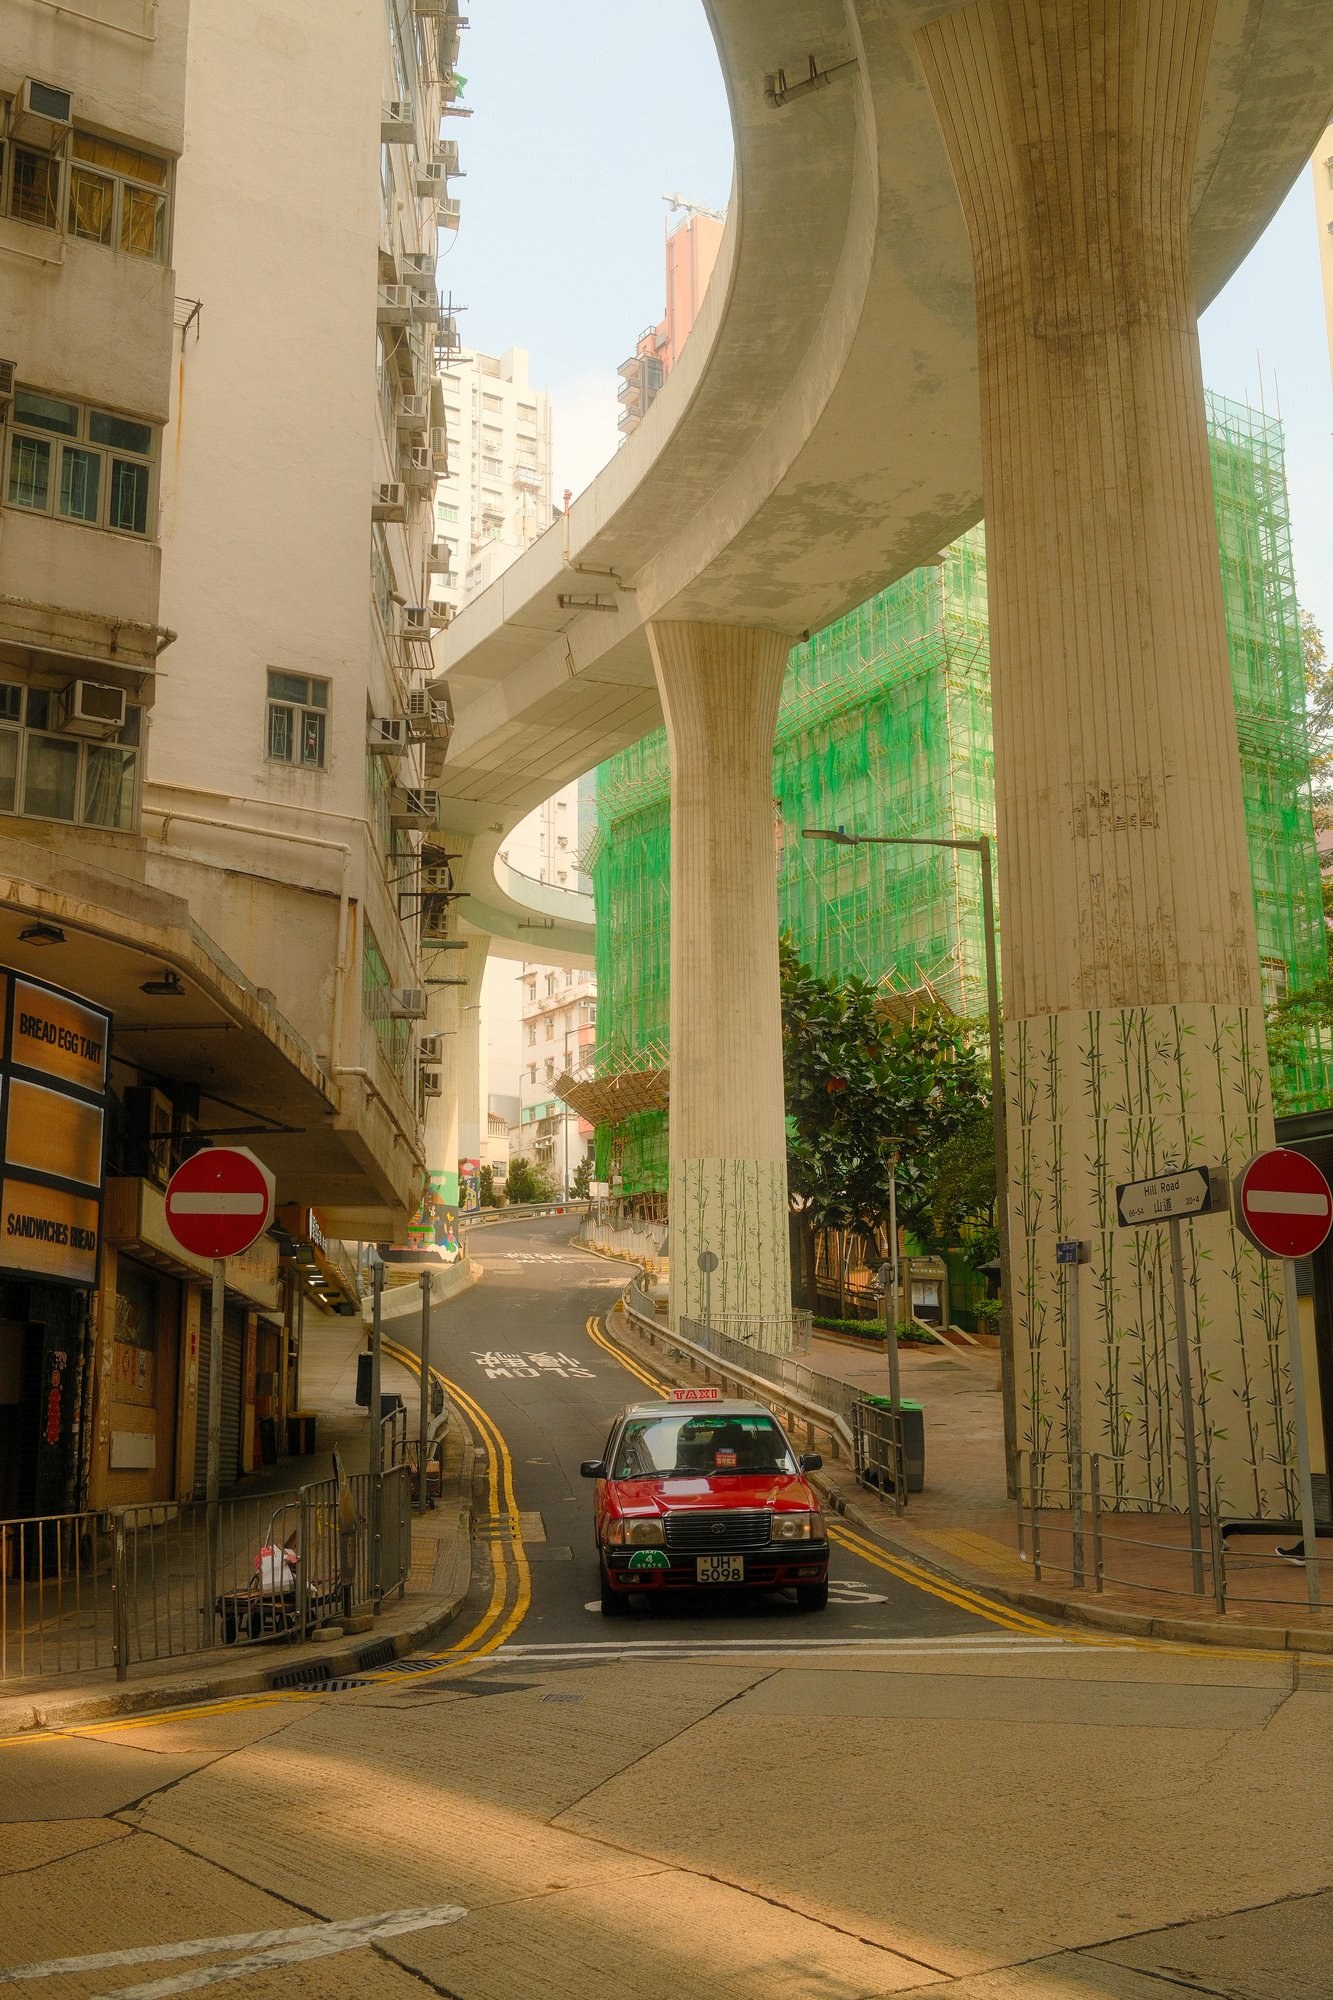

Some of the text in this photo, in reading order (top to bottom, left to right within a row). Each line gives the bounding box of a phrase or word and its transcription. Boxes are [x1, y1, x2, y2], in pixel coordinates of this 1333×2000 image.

[20, 1013, 103, 1064] BREAD EGG TART
[1144, 1179, 1180, 1197] Hill Road
[1153, 1197, 1173, 1214] 山道
[1185, 1195, 1200, 1206] 20-4
[1128, 1208, 1145, 1218] 66-54
[7, 1213, 69, 1246] SANDWICHES
[484, 1367, 597, 1379] SLOW
[673, 1389, 718, 1400] TAXI
[645, 1554, 654, 1564] 4
[710, 1556, 731, 1569] UH
[700, 1569, 741, 1582] 5098
